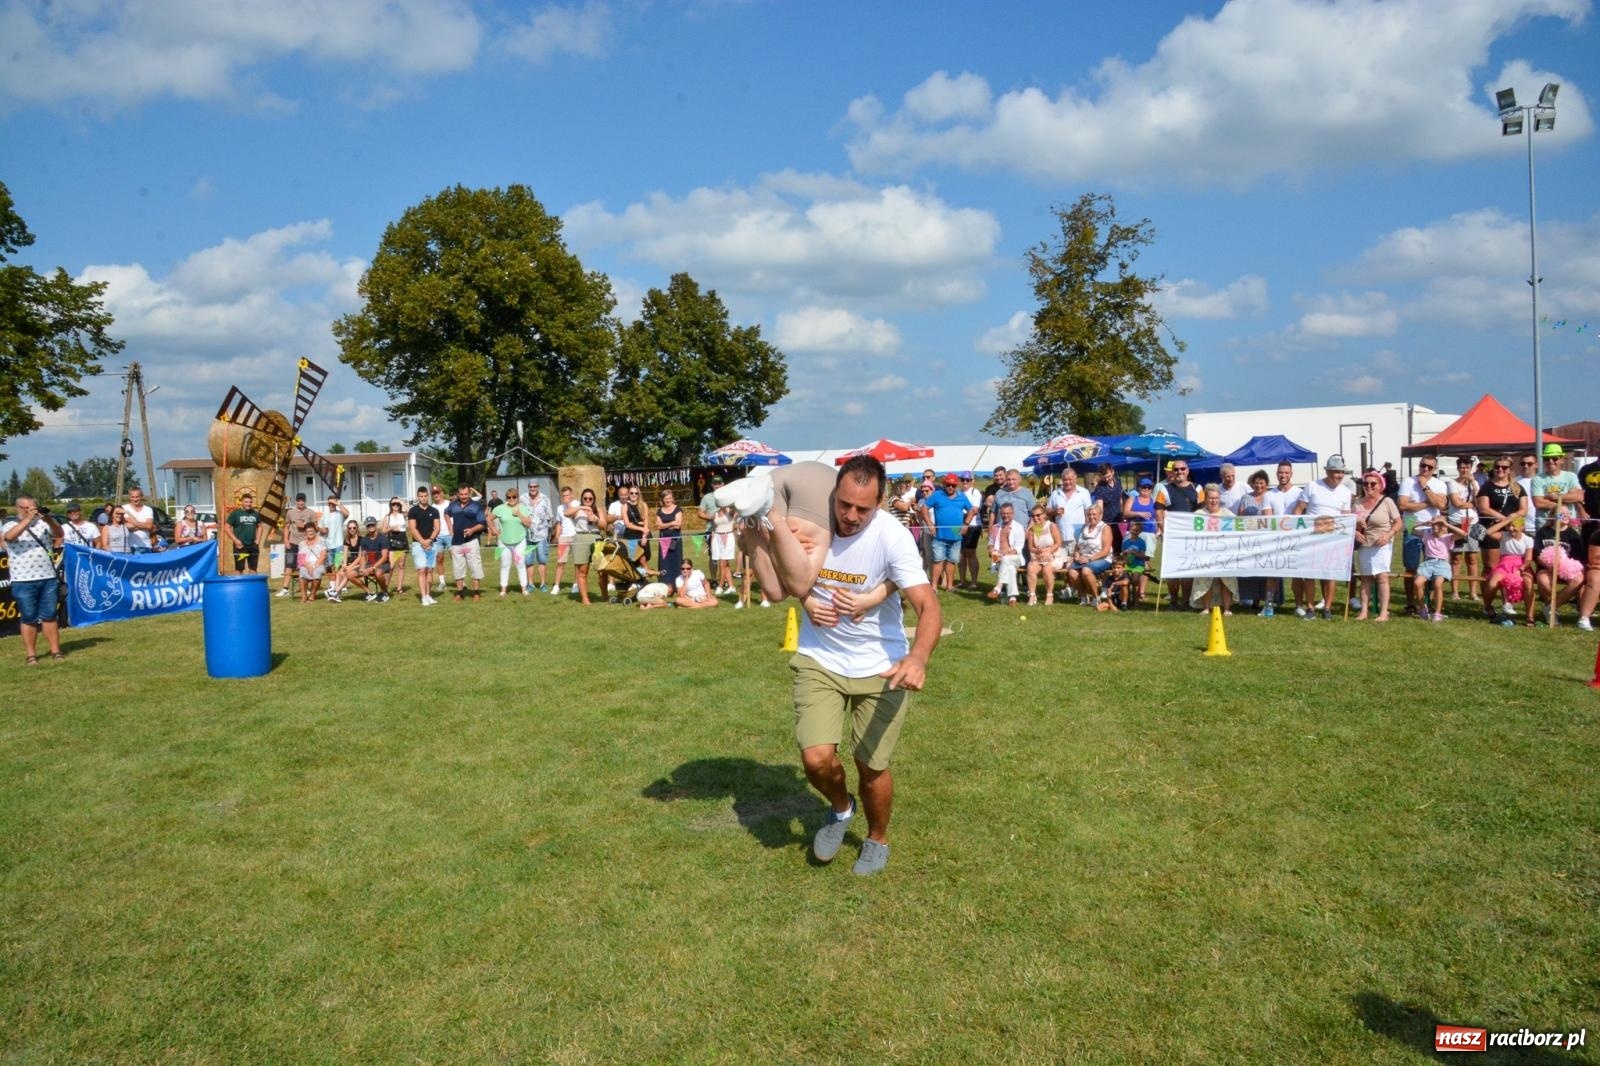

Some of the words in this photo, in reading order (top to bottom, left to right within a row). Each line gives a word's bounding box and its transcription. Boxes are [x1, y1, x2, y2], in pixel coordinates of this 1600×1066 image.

[1237, 536, 1263, 552] NA
[1271, 535, 1303, 552] 102
[1177, 555, 1246, 571] ZAWSZE
[130, 567, 194, 588] GMINA
